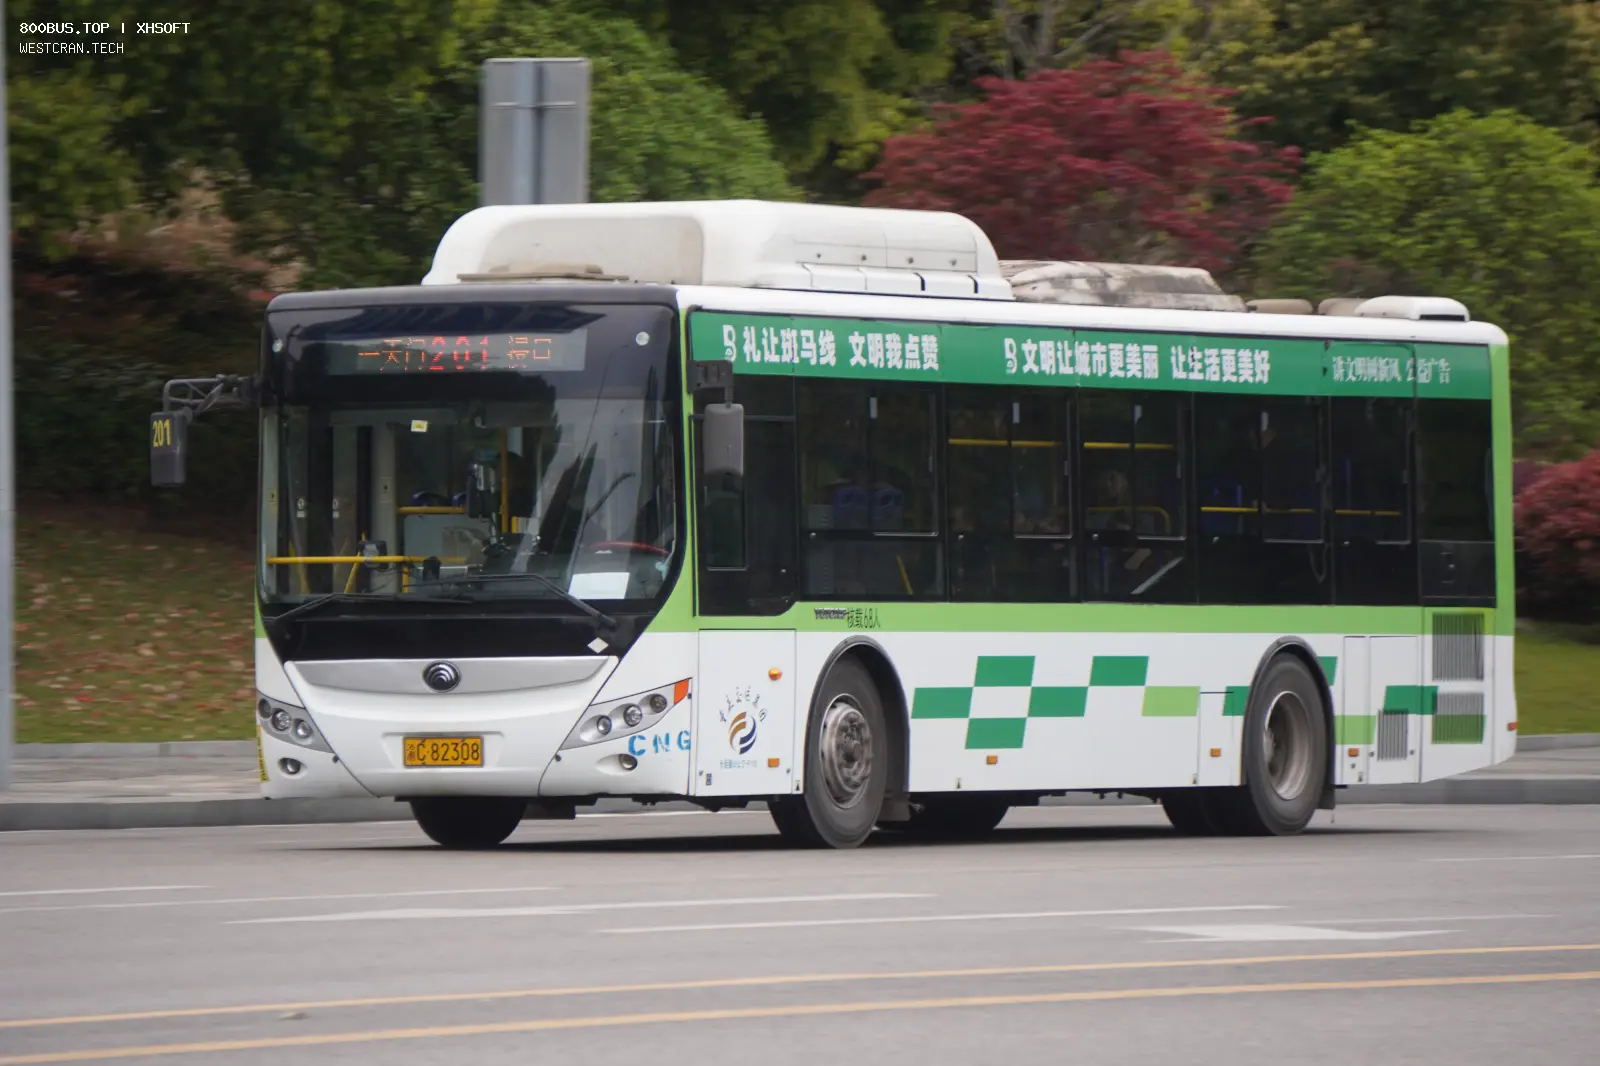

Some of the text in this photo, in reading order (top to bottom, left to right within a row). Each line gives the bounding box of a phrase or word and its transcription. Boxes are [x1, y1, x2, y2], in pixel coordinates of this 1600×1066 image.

[429, 335, 489, 371] 201
[743, 326, 940, 371] 礼让斑马线 文明我点赞
[1021, 338, 1271, 384] 文明让城市更美丽 让生活更美好
[152, 418, 172, 448] 201
[628, 730, 692, 756] CNG
